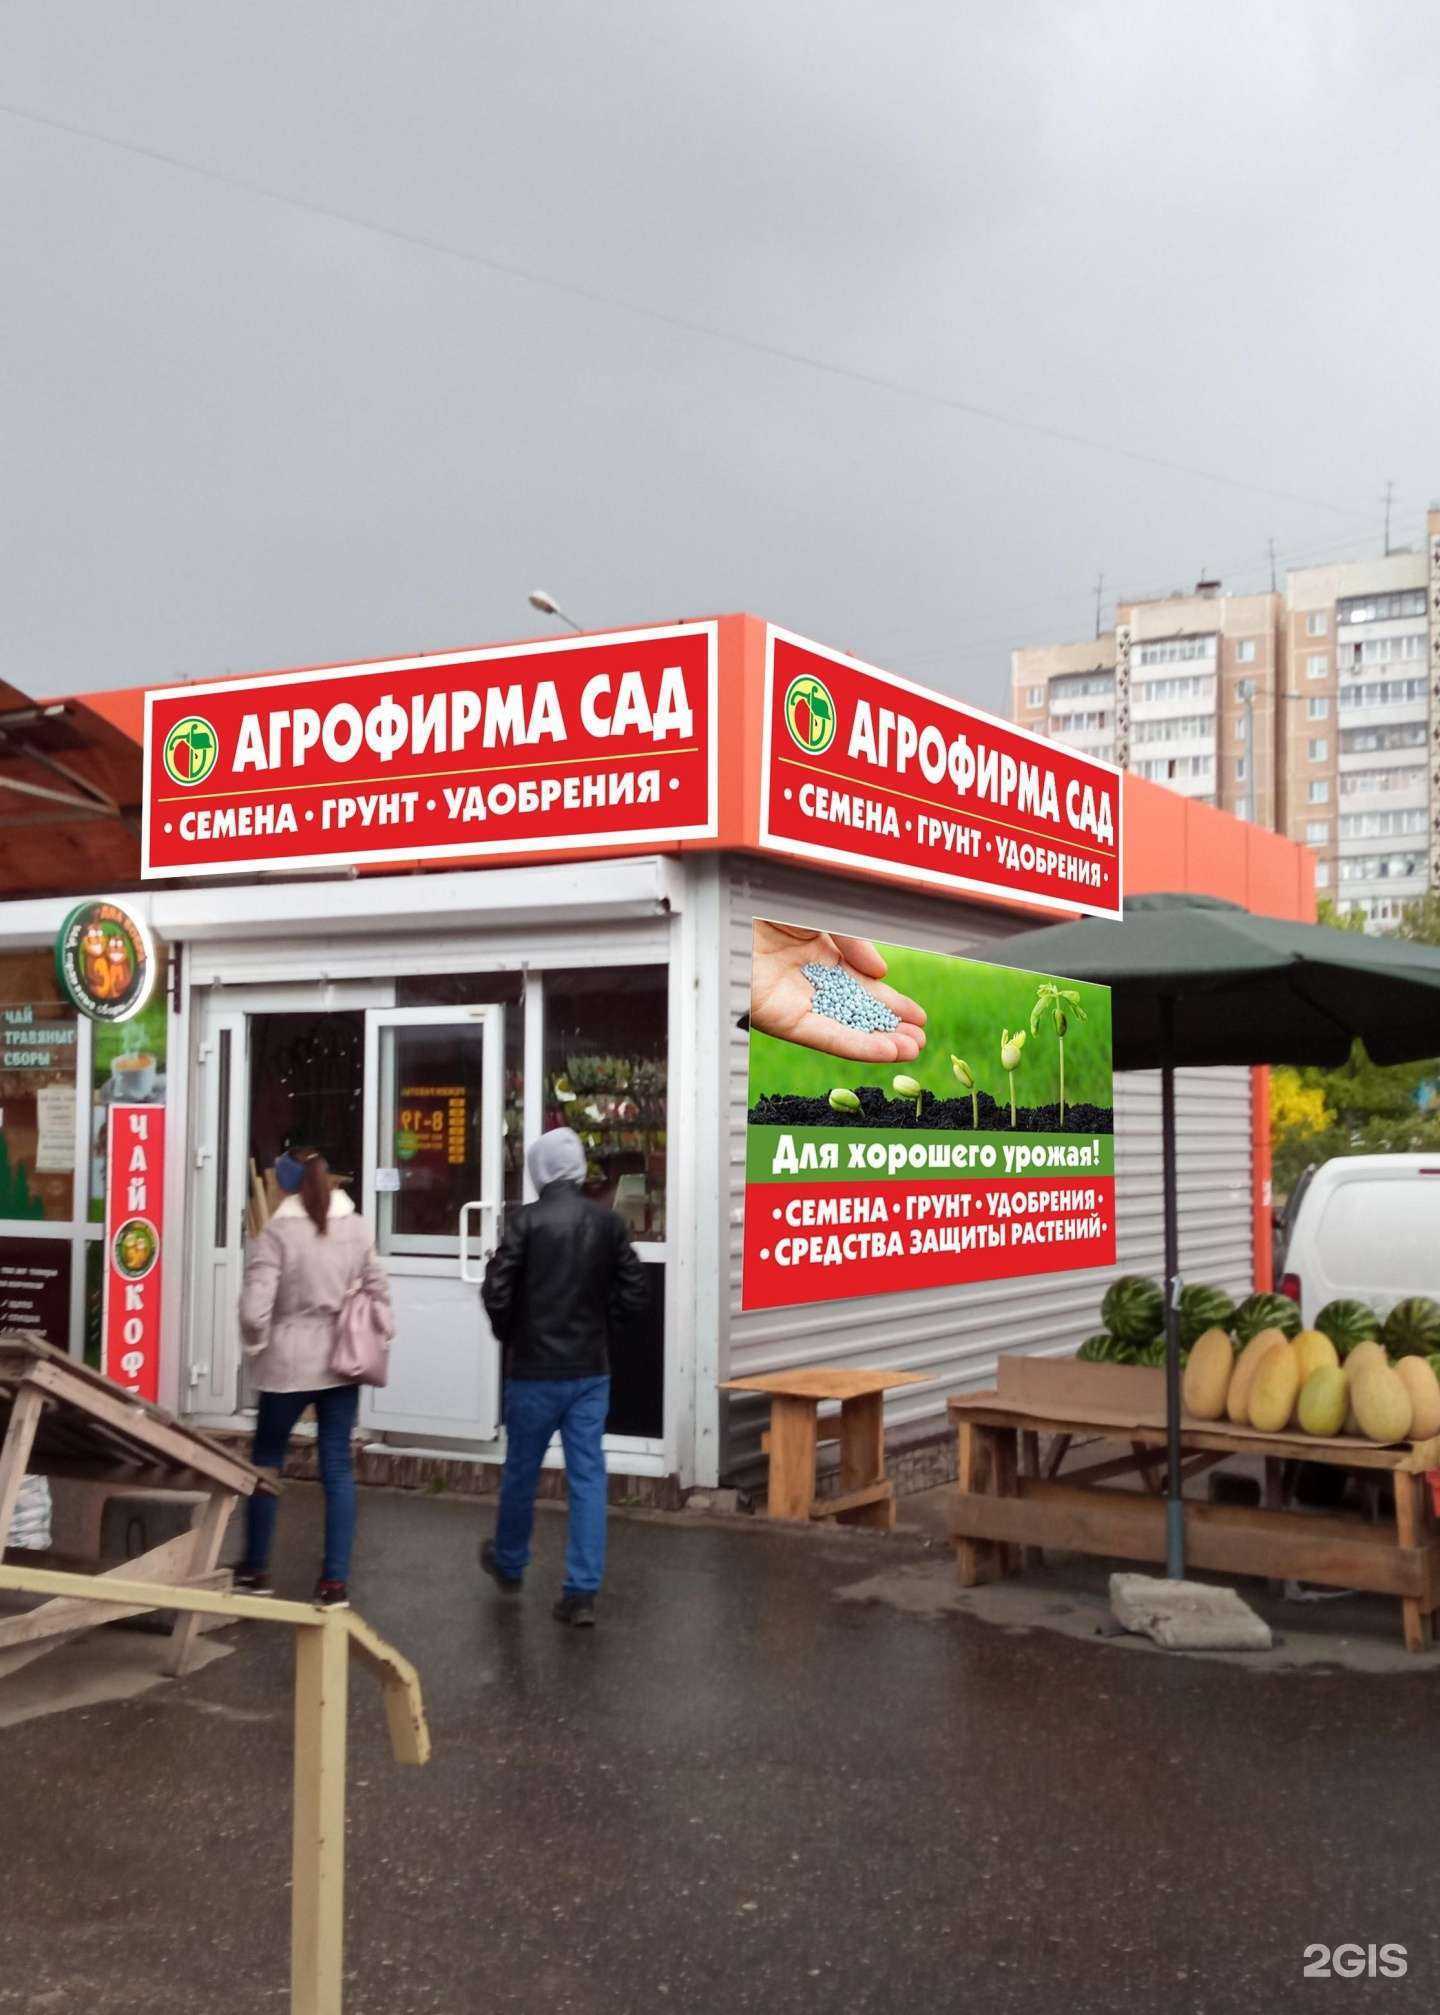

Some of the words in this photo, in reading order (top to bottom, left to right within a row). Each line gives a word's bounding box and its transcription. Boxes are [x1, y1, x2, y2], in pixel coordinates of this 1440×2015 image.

[232, 680, 567, 773] АГРОФИРМА
[579, 665, 694, 741] САД
[847, 699, 1060, 822] АГРОФИРМА
[1066, 779, 1114, 846] САД
[179, 803, 298, 841] СЕМЕНА
[321, 791, 418, 830] ГРУНТ
[442, 769, 661, 824] УДОБРЕНИЯ
[799, 783, 901, 838] СЕМЕНА
[917, 815, 982, 857] ГРУНТ
[995, 836, 1102, 887] УДОБРЕНИЯ
[4, 1005, 33, 1024] ЧАЙ
[4, 1051, 50, 1066] СБОРЫ
[127, 1113, 148, 1212] ЧАЙ
[772, 1134, 839, 1174] Для
[848, 1141, 997, 1175] хорошего
[1002, 1139, 1100, 1173] урожая!
[774, 1232, 904, 1267] СРЕДСТВА
[909, 1221, 1007, 1255] ЗАЩИТЫ
[1011, 1212, 1101, 1243] РАСТЕНИЙ
[785, 1197, 888, 1227] СЕМЕНА
[906, 1193, 972, 1220] ГРУНТ
[985, 1189, 1096, 1215] УДОБРЕНИЯ
